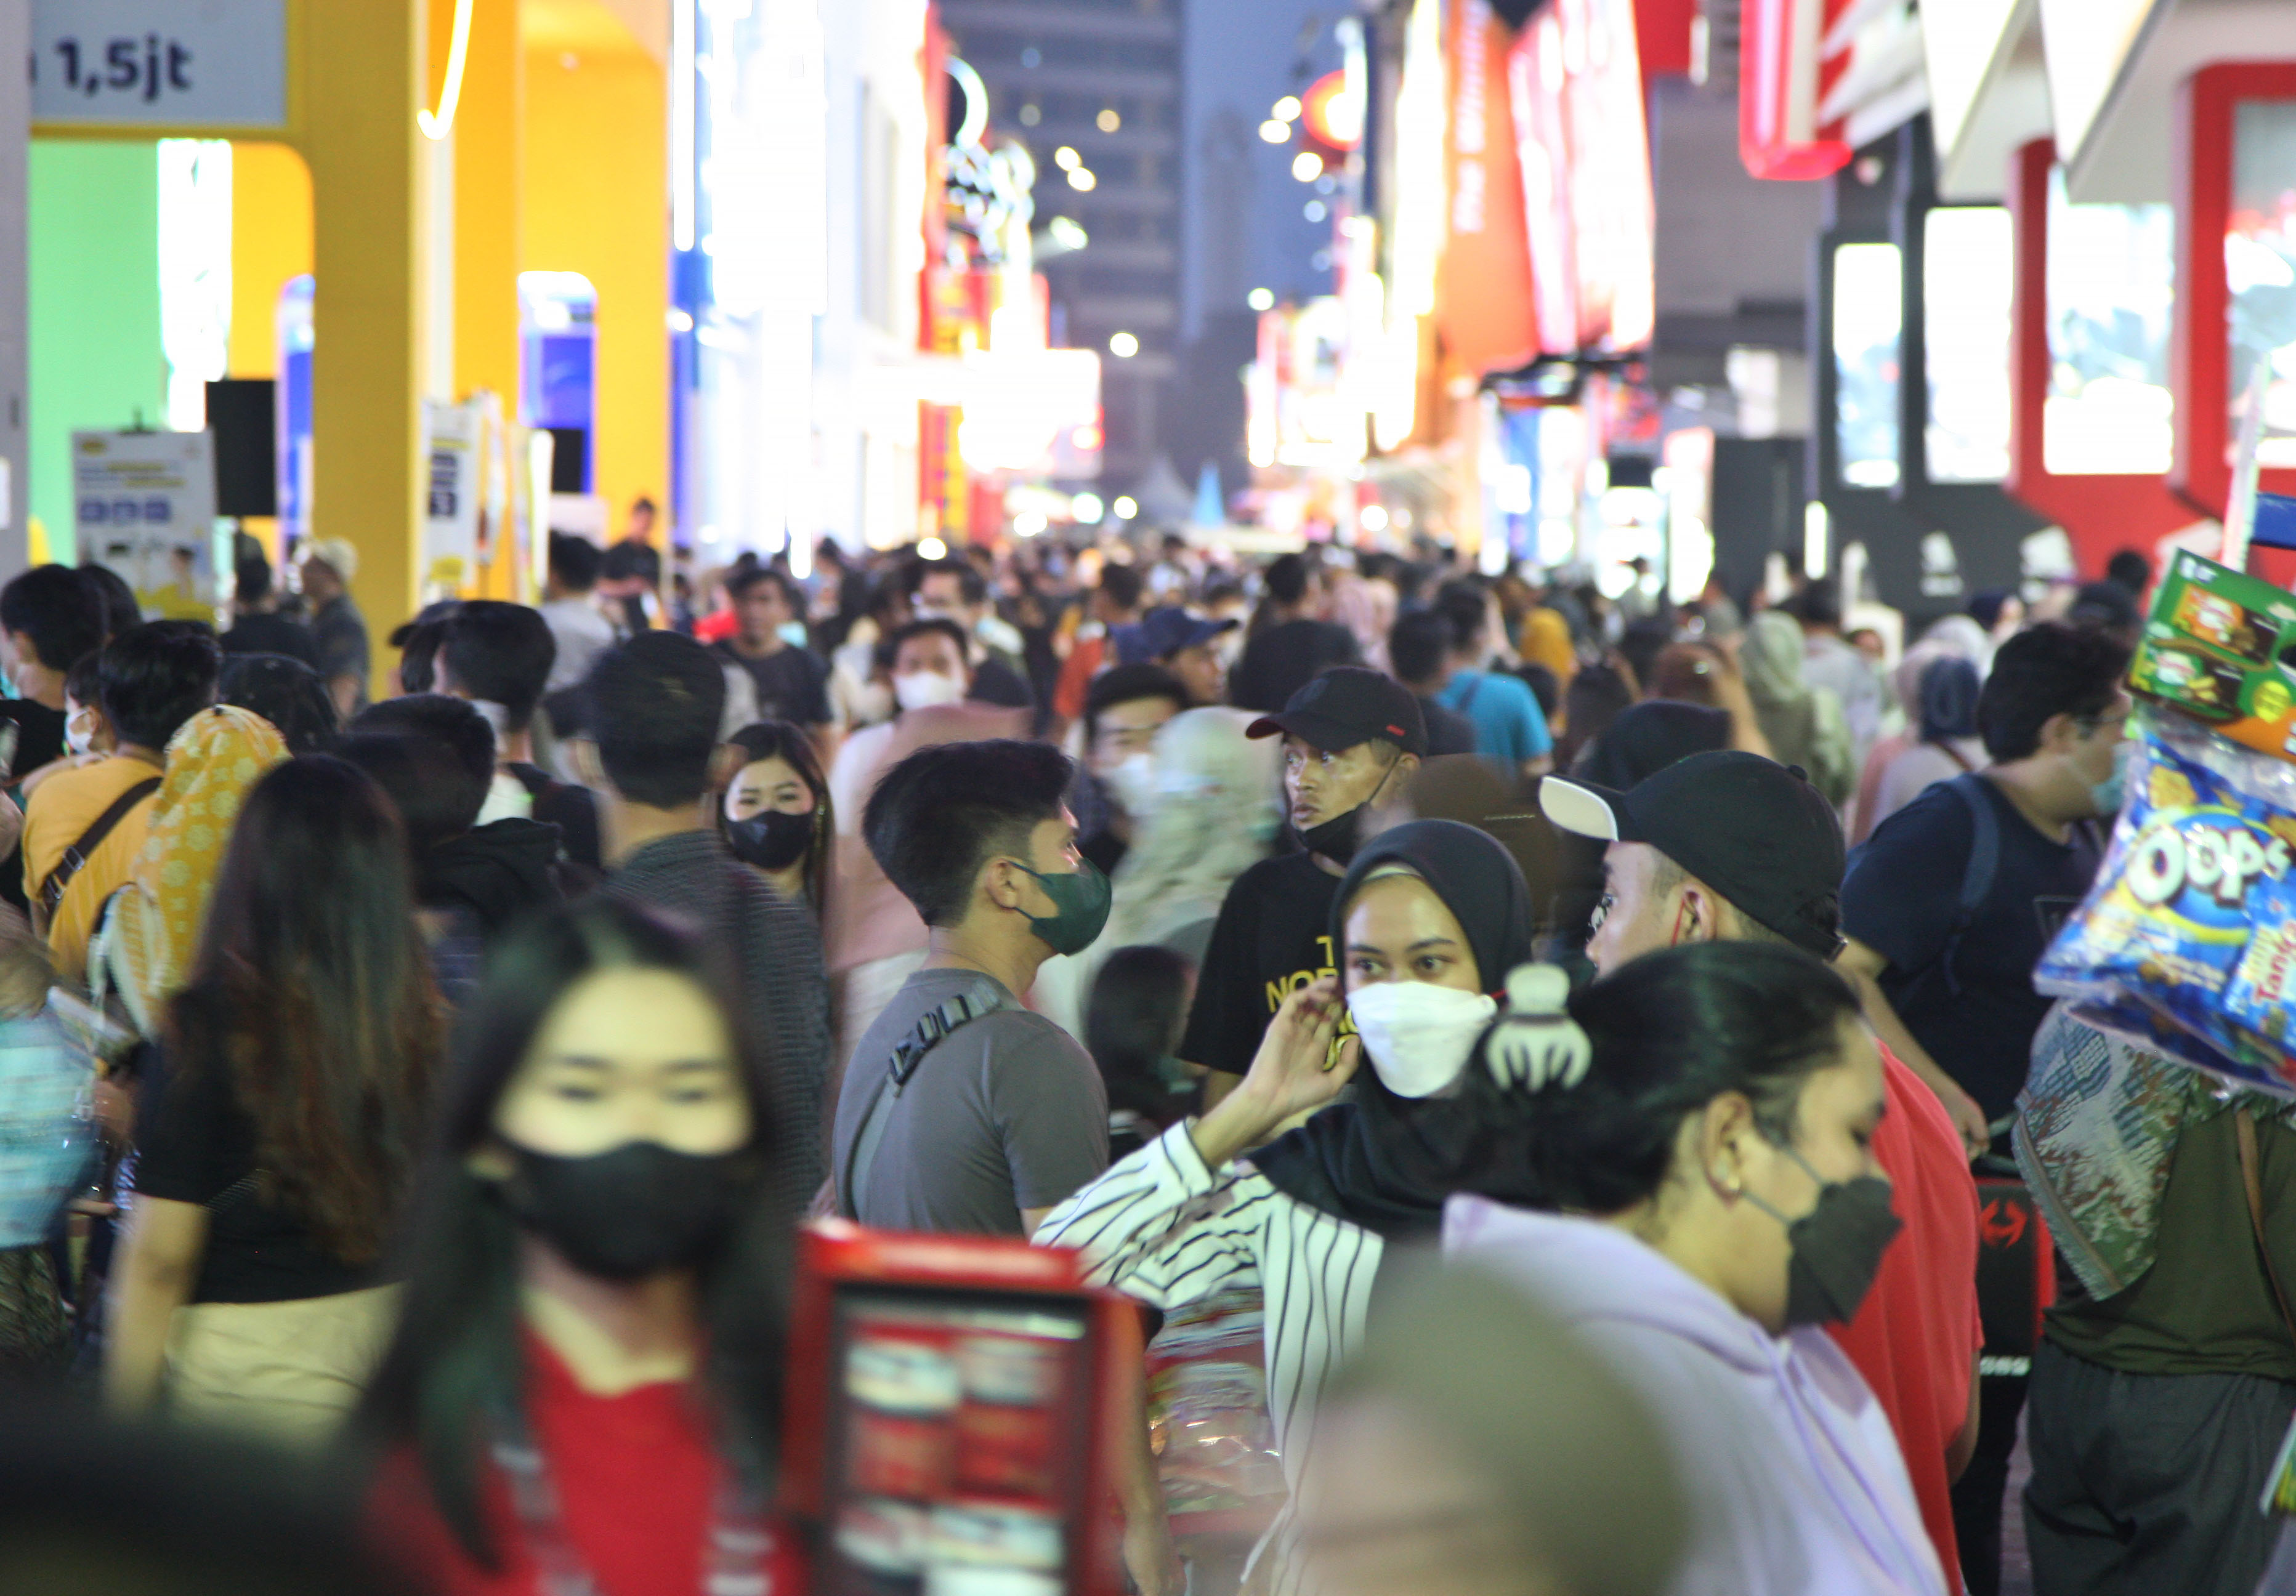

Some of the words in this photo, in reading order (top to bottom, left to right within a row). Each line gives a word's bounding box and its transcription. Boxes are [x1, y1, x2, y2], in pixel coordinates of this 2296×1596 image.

[55, 33, 192, 102] 1,5jt
[2127, 824, 2290, 904] Oops
[1316, 935, 1335, 967] T
[1266, 967, 1338, 1014] NO
